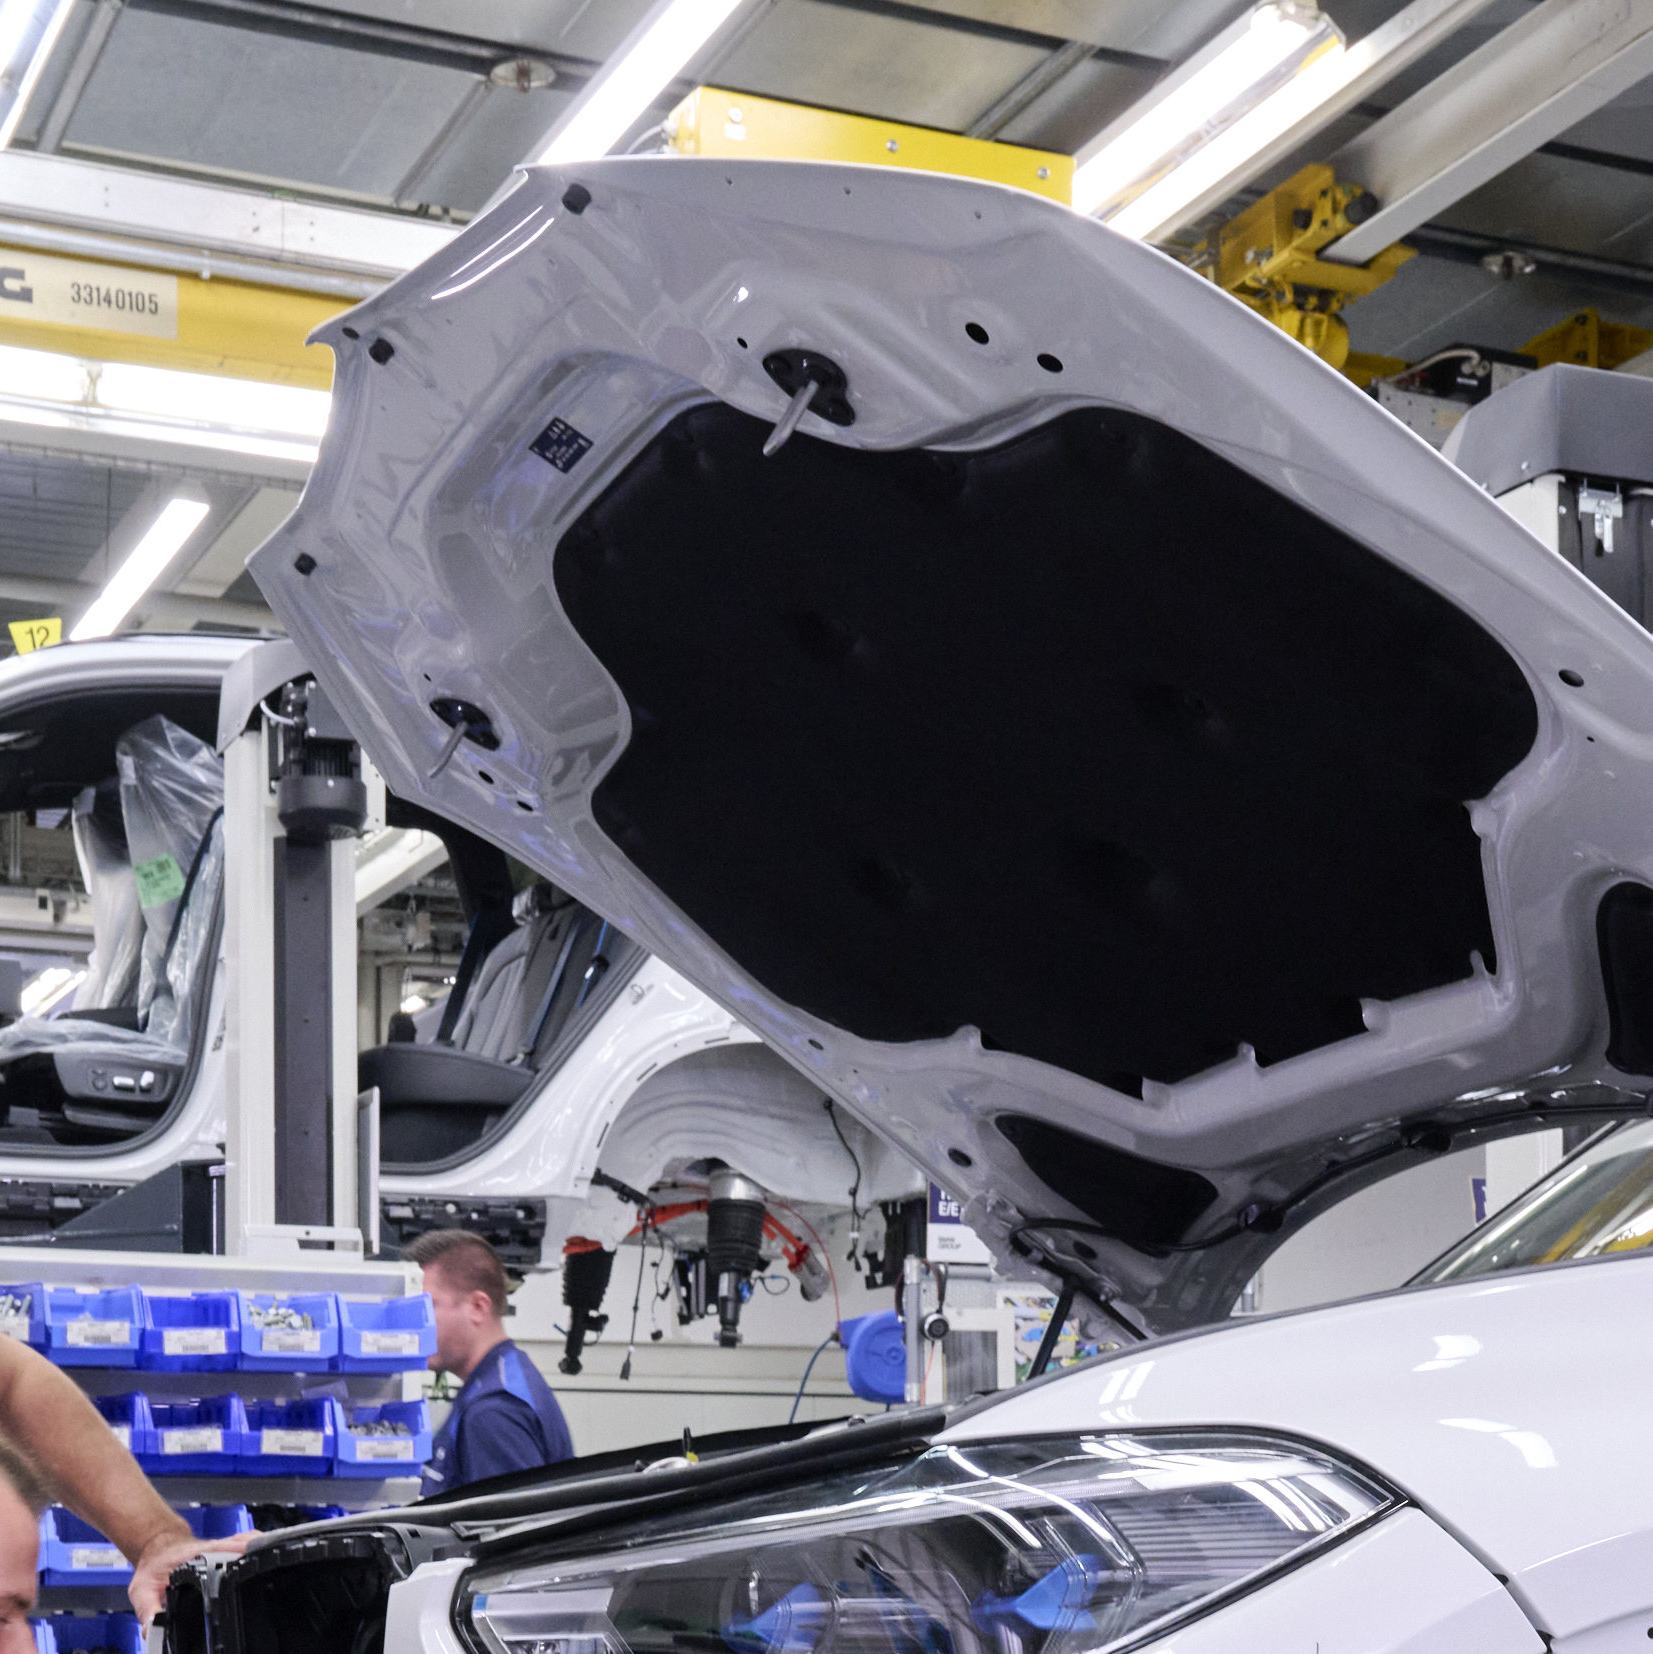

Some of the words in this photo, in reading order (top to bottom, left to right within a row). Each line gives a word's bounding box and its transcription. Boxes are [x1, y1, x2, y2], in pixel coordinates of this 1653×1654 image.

[70, 281, 160, 317] 33140105
[26, 625, 50, 650] 12
[938, 1200, 964, 1217] E/E
